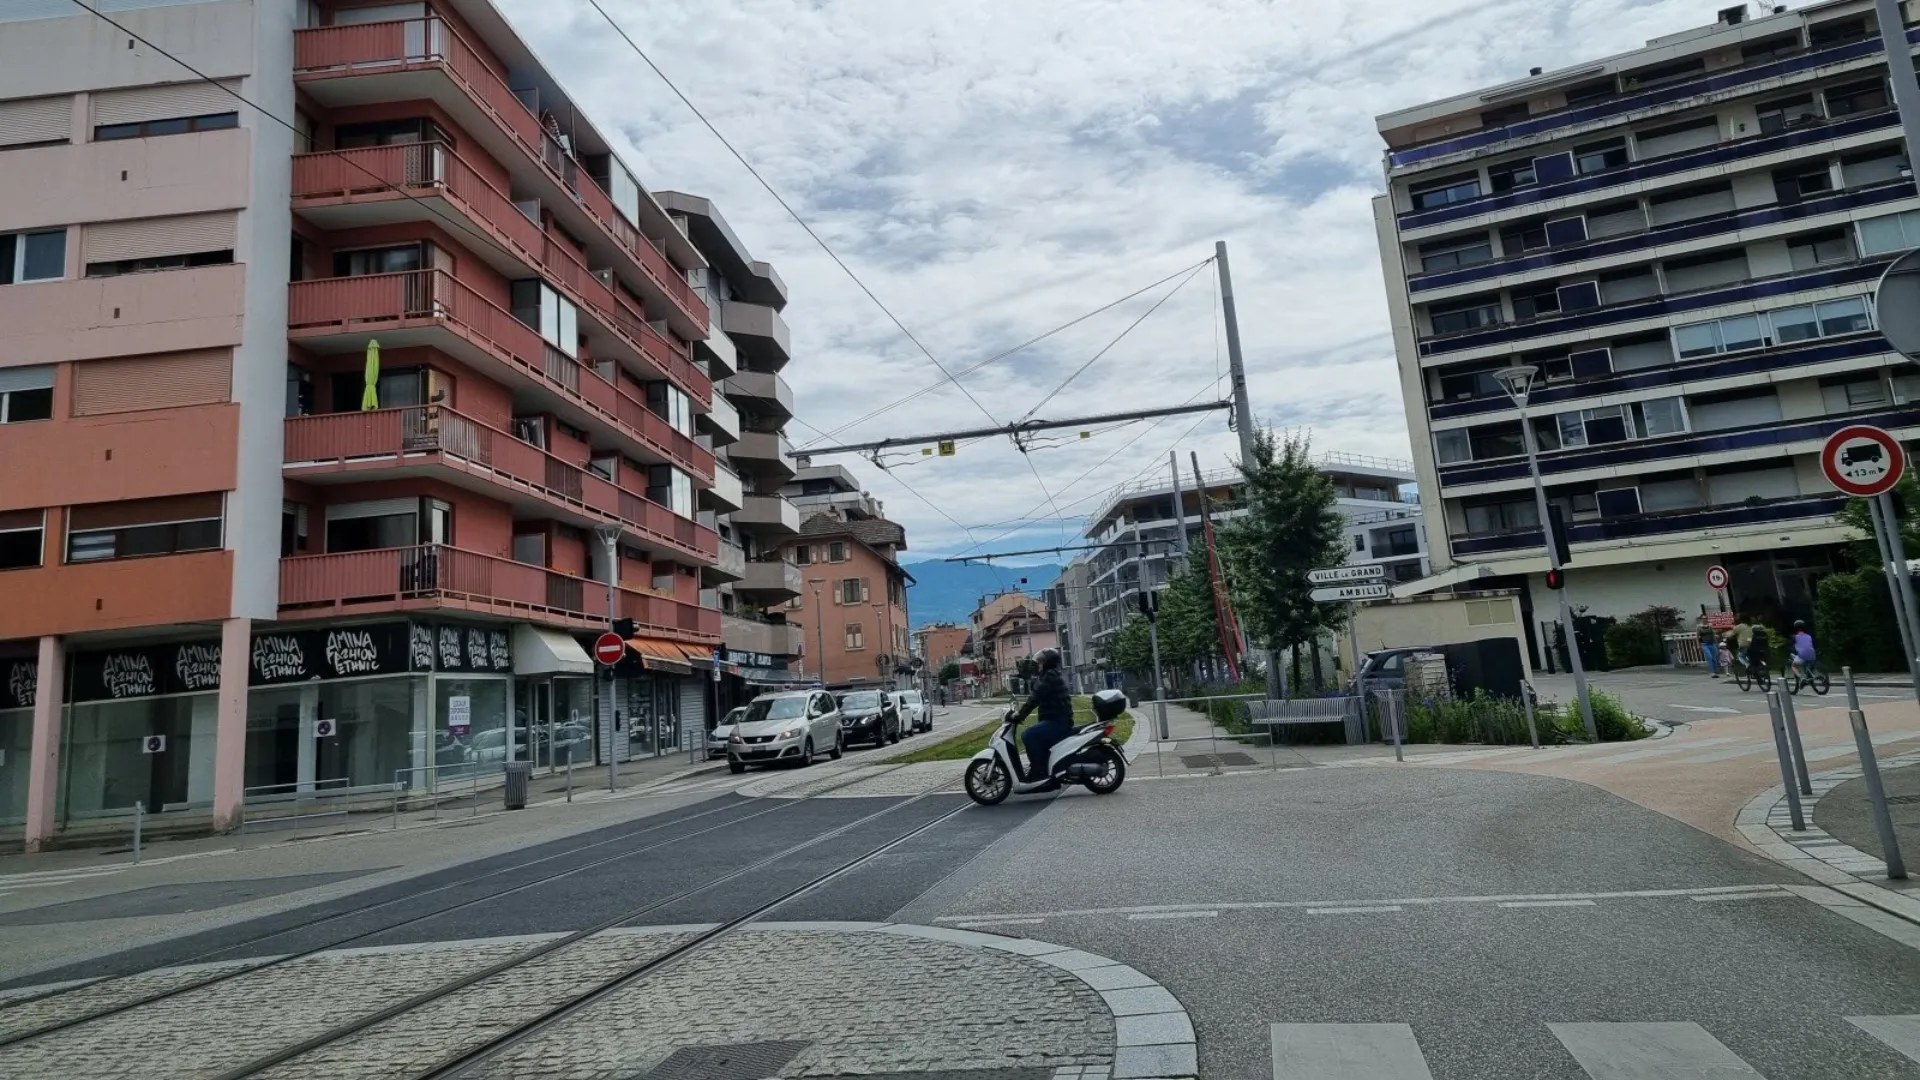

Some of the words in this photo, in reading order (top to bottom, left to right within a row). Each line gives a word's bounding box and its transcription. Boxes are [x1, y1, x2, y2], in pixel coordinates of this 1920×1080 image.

[1853, 468, 1867, 477] 13
[1314, 570, 1339, 580] VILLE
[1350, 567, 1381, 577] GRAND
[1339, 586, 1383, 597] AMBILLY
[254, 635, 302, 656] AMINA
[327, 630, 375, 652] AMINA
[103, 653, 152, 674] AMINA
[335, 659, 380, 675] ETHNIC
[262, 664, 306, 680] ETHNIC
[185, 674, 220, 689] ETHNI
[112, 682, 156, 698] ETHNIC
